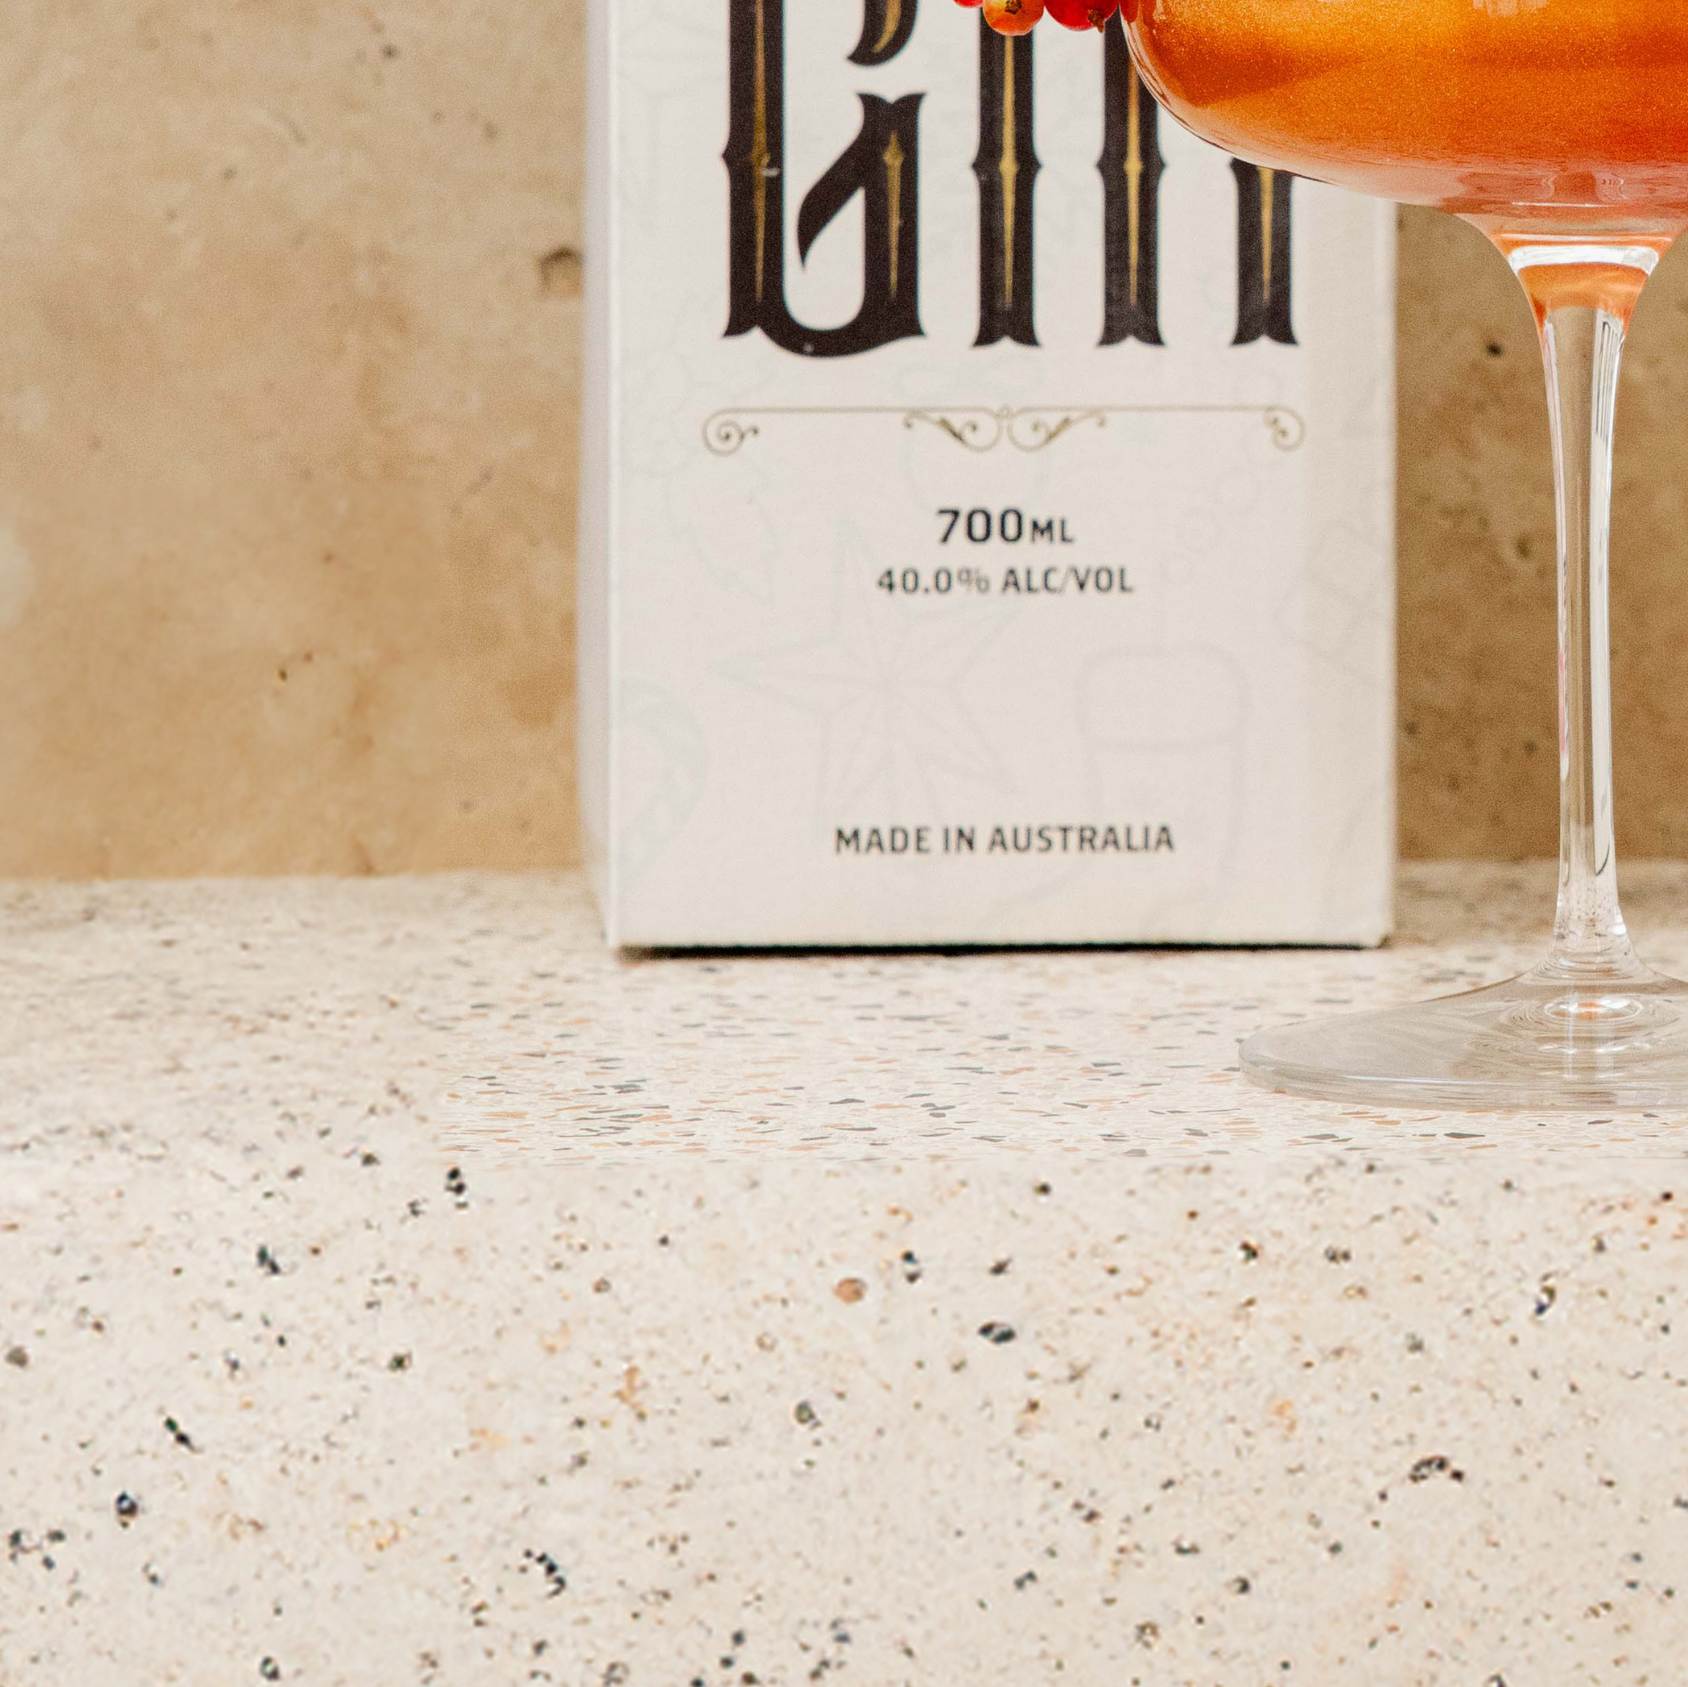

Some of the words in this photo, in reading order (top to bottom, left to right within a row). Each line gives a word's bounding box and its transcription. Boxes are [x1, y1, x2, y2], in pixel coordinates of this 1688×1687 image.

[936, 508, 1075, 544] 700ML
[877, 567, 990, 595] 40.0%
[1001, 567, 1134, 595] ALC/VOL
[835, 825, 931, 853] MADE
[943, 826, 975, 852] IN
[988, 824, 1175, 852] AUSTRALIA
